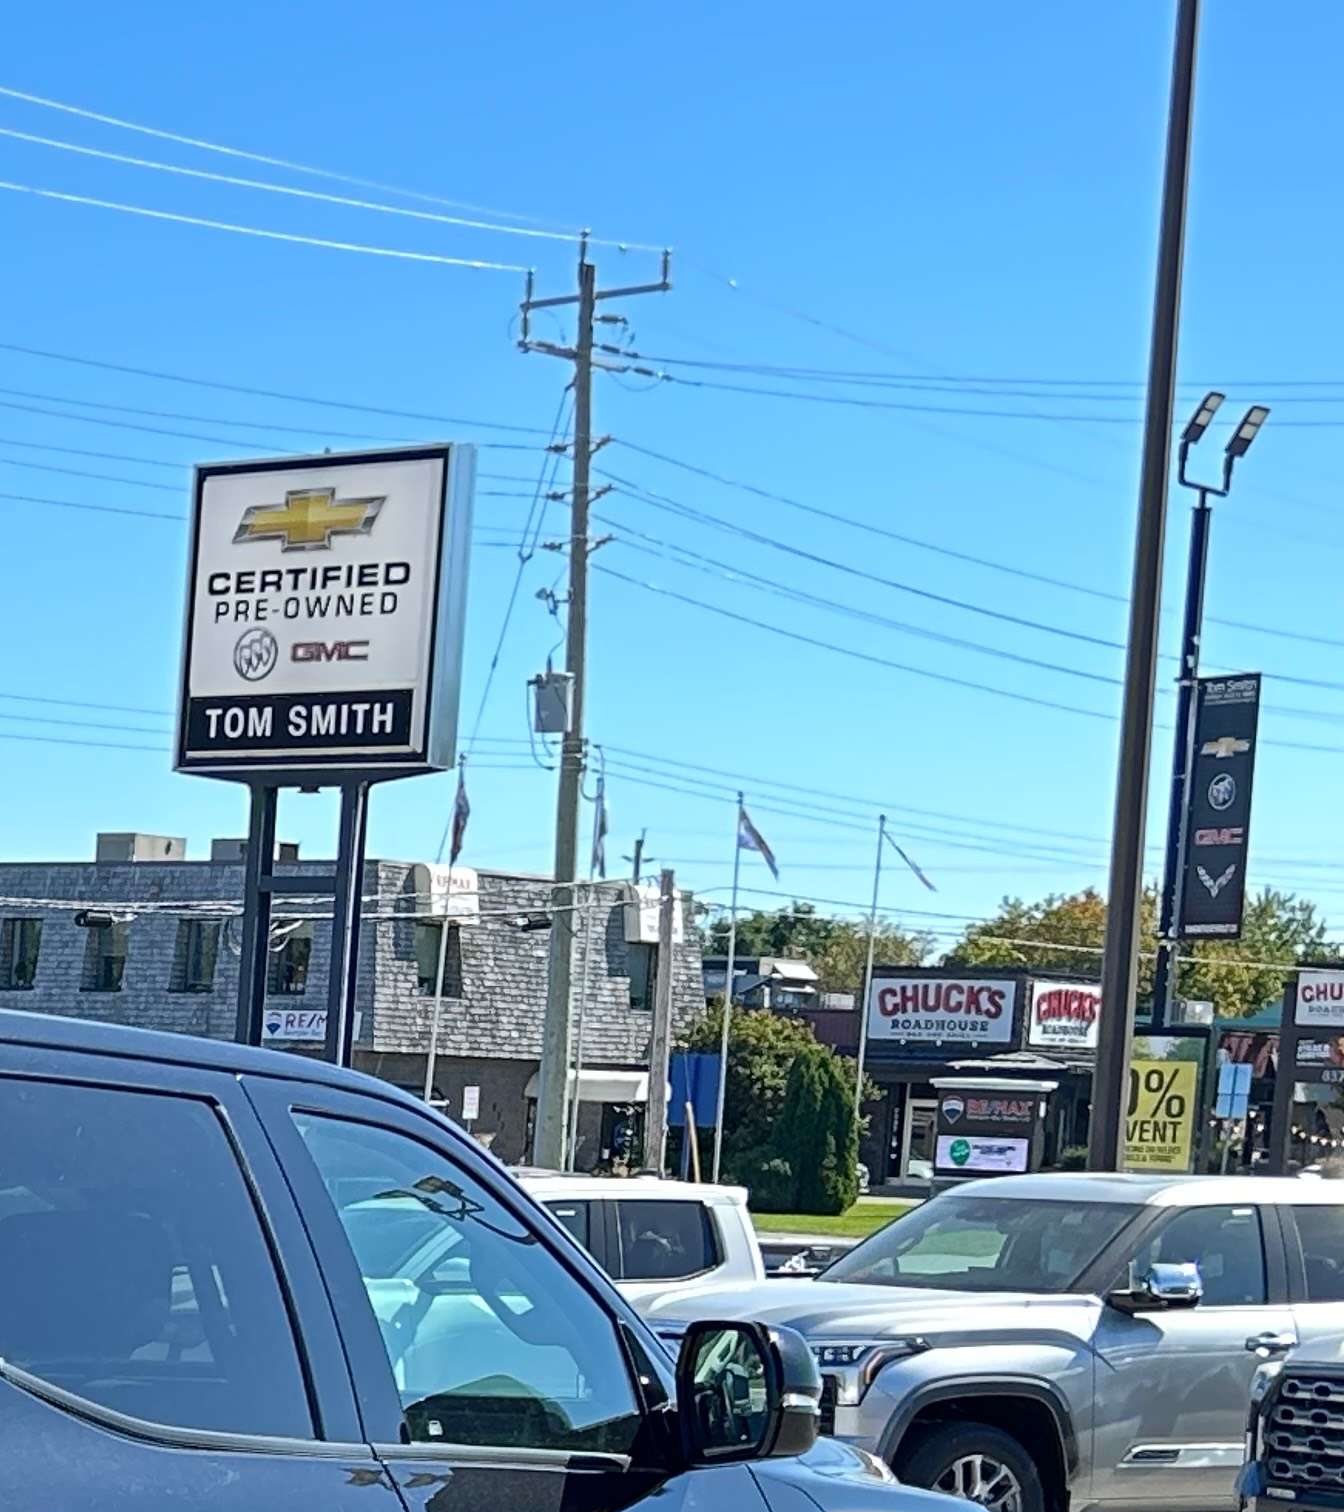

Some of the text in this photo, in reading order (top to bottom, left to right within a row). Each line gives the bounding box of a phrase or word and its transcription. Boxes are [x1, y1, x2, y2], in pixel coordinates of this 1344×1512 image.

[207, 561, 411, 596] CERTIFIED
[214, 591, 399, 624] PRE-OWNED
[290, 639, 370, 663] GMC
[205, 702, 395, 739] TOM SMITH
[890, 1018, 990, 1033] ROADHOUSE
[1125, 1119, 1183, 1144] VENT
